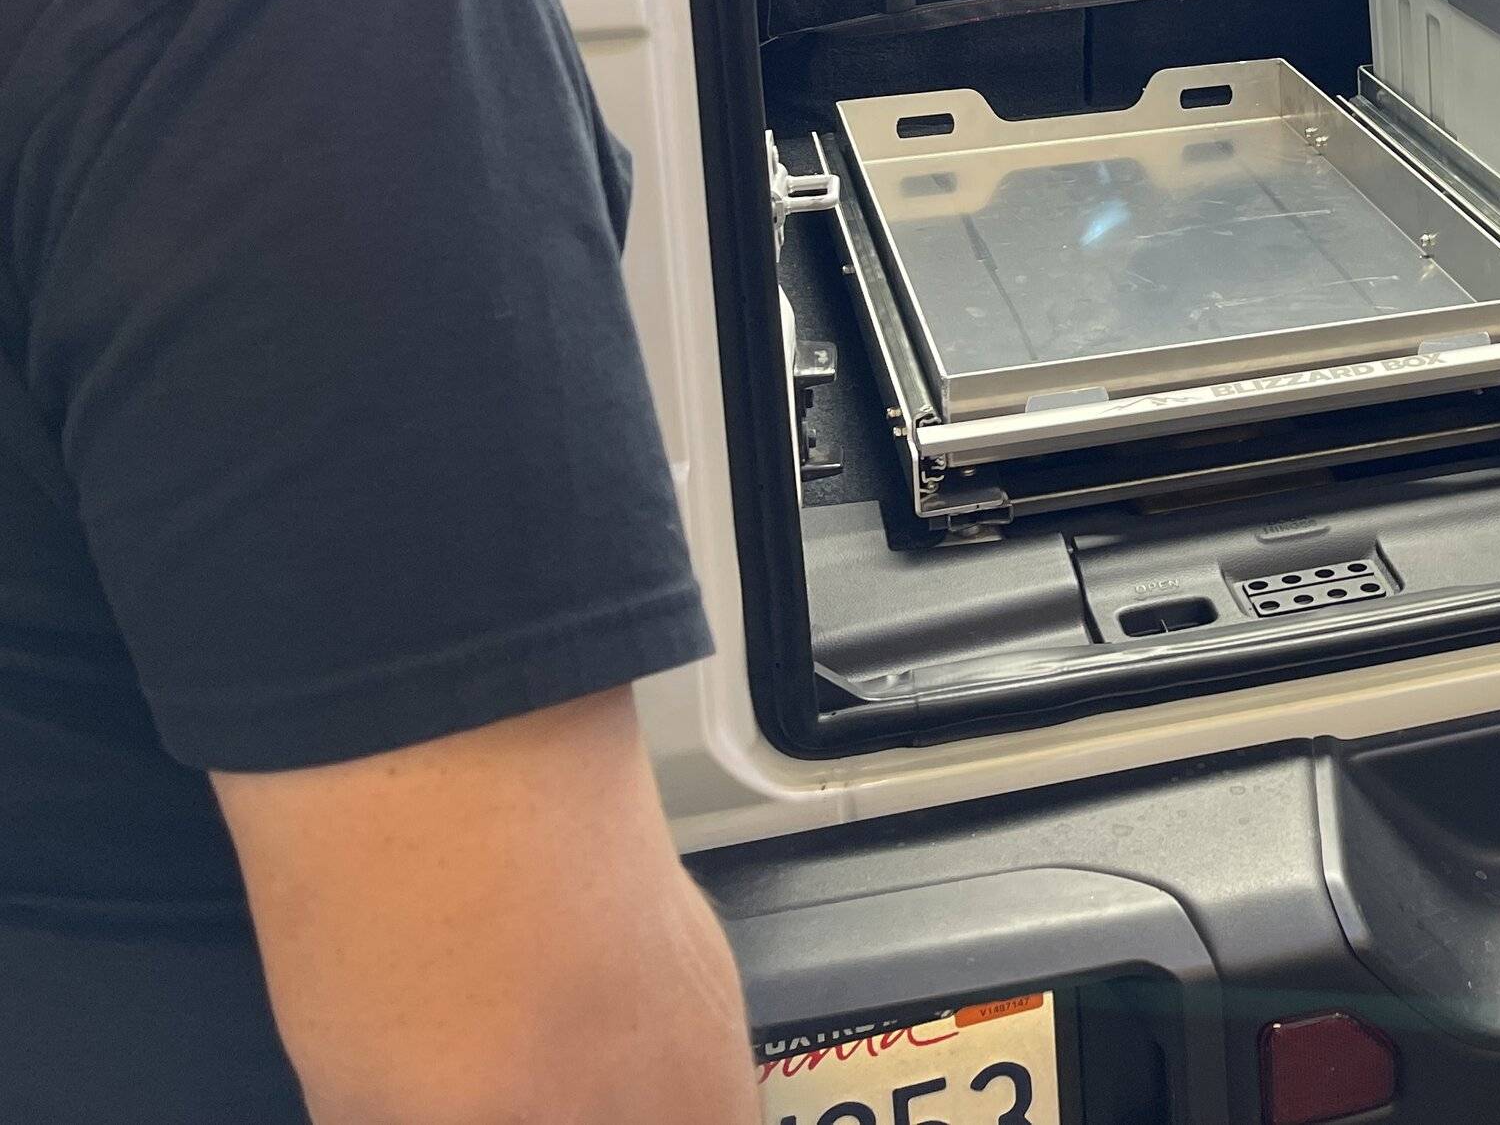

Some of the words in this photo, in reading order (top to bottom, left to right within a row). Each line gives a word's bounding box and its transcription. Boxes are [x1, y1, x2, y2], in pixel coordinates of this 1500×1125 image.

[1209, 363, 1376, 399] BLIZZARD
[1381, 352, 1447, 373] BOX
[1134, 578, 1180, 595] OPEN
